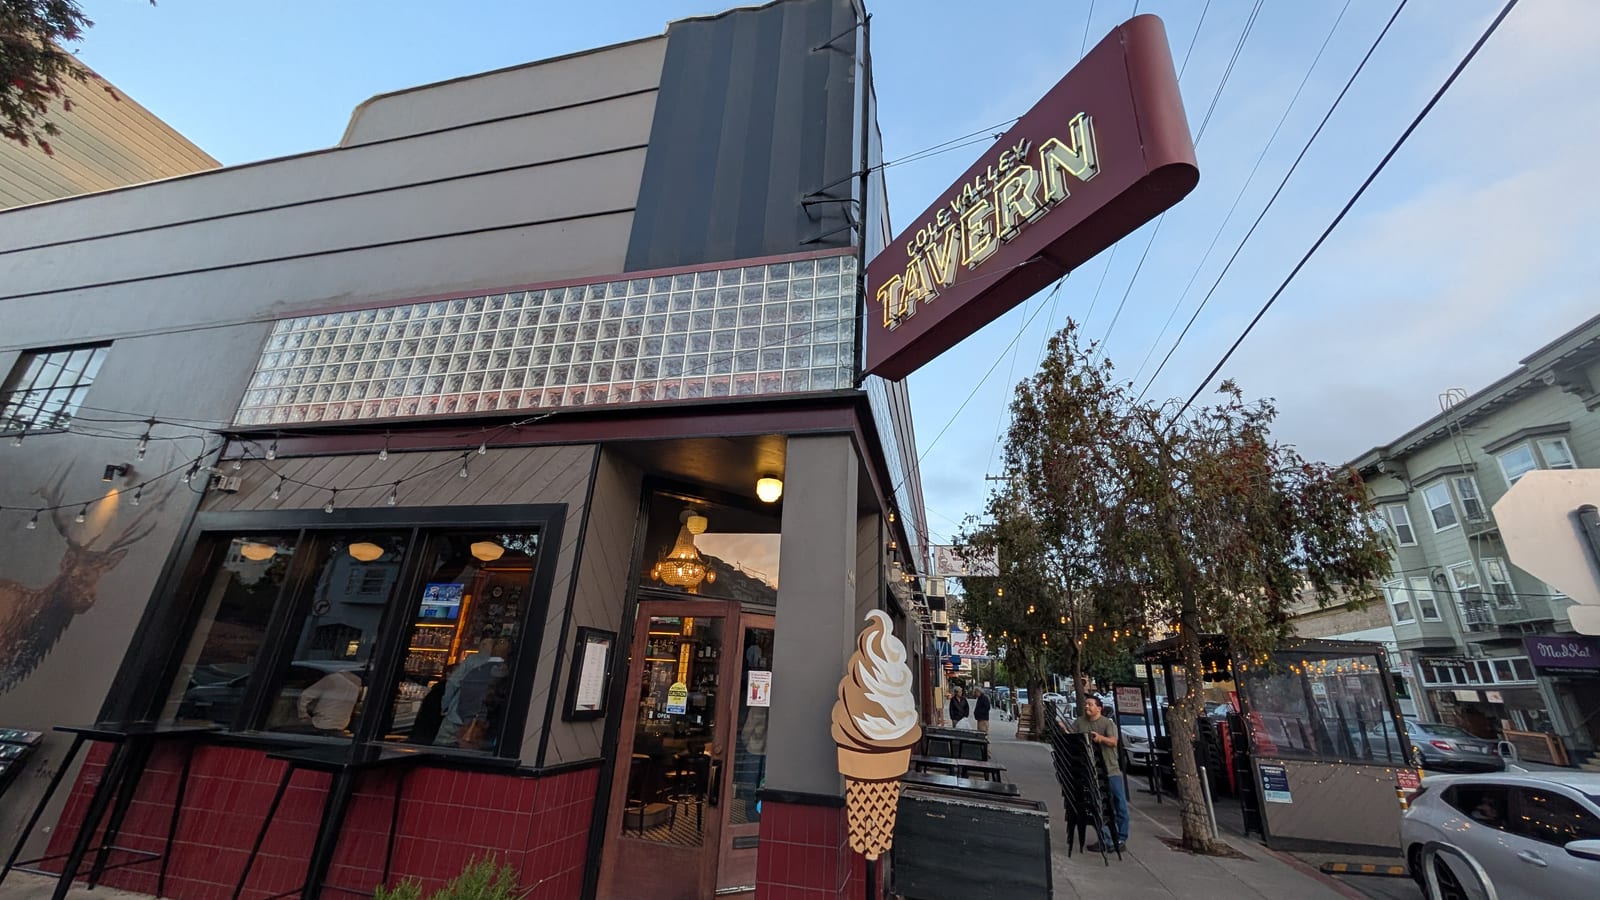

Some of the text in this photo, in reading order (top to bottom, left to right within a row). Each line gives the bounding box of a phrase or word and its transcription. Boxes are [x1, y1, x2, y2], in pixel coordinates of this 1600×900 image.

[876, 111, 1100, 331] TAVERN
[906, 137, 1030, 258] COLE VALLEY
[957, 648, 987, 656] CHASE
